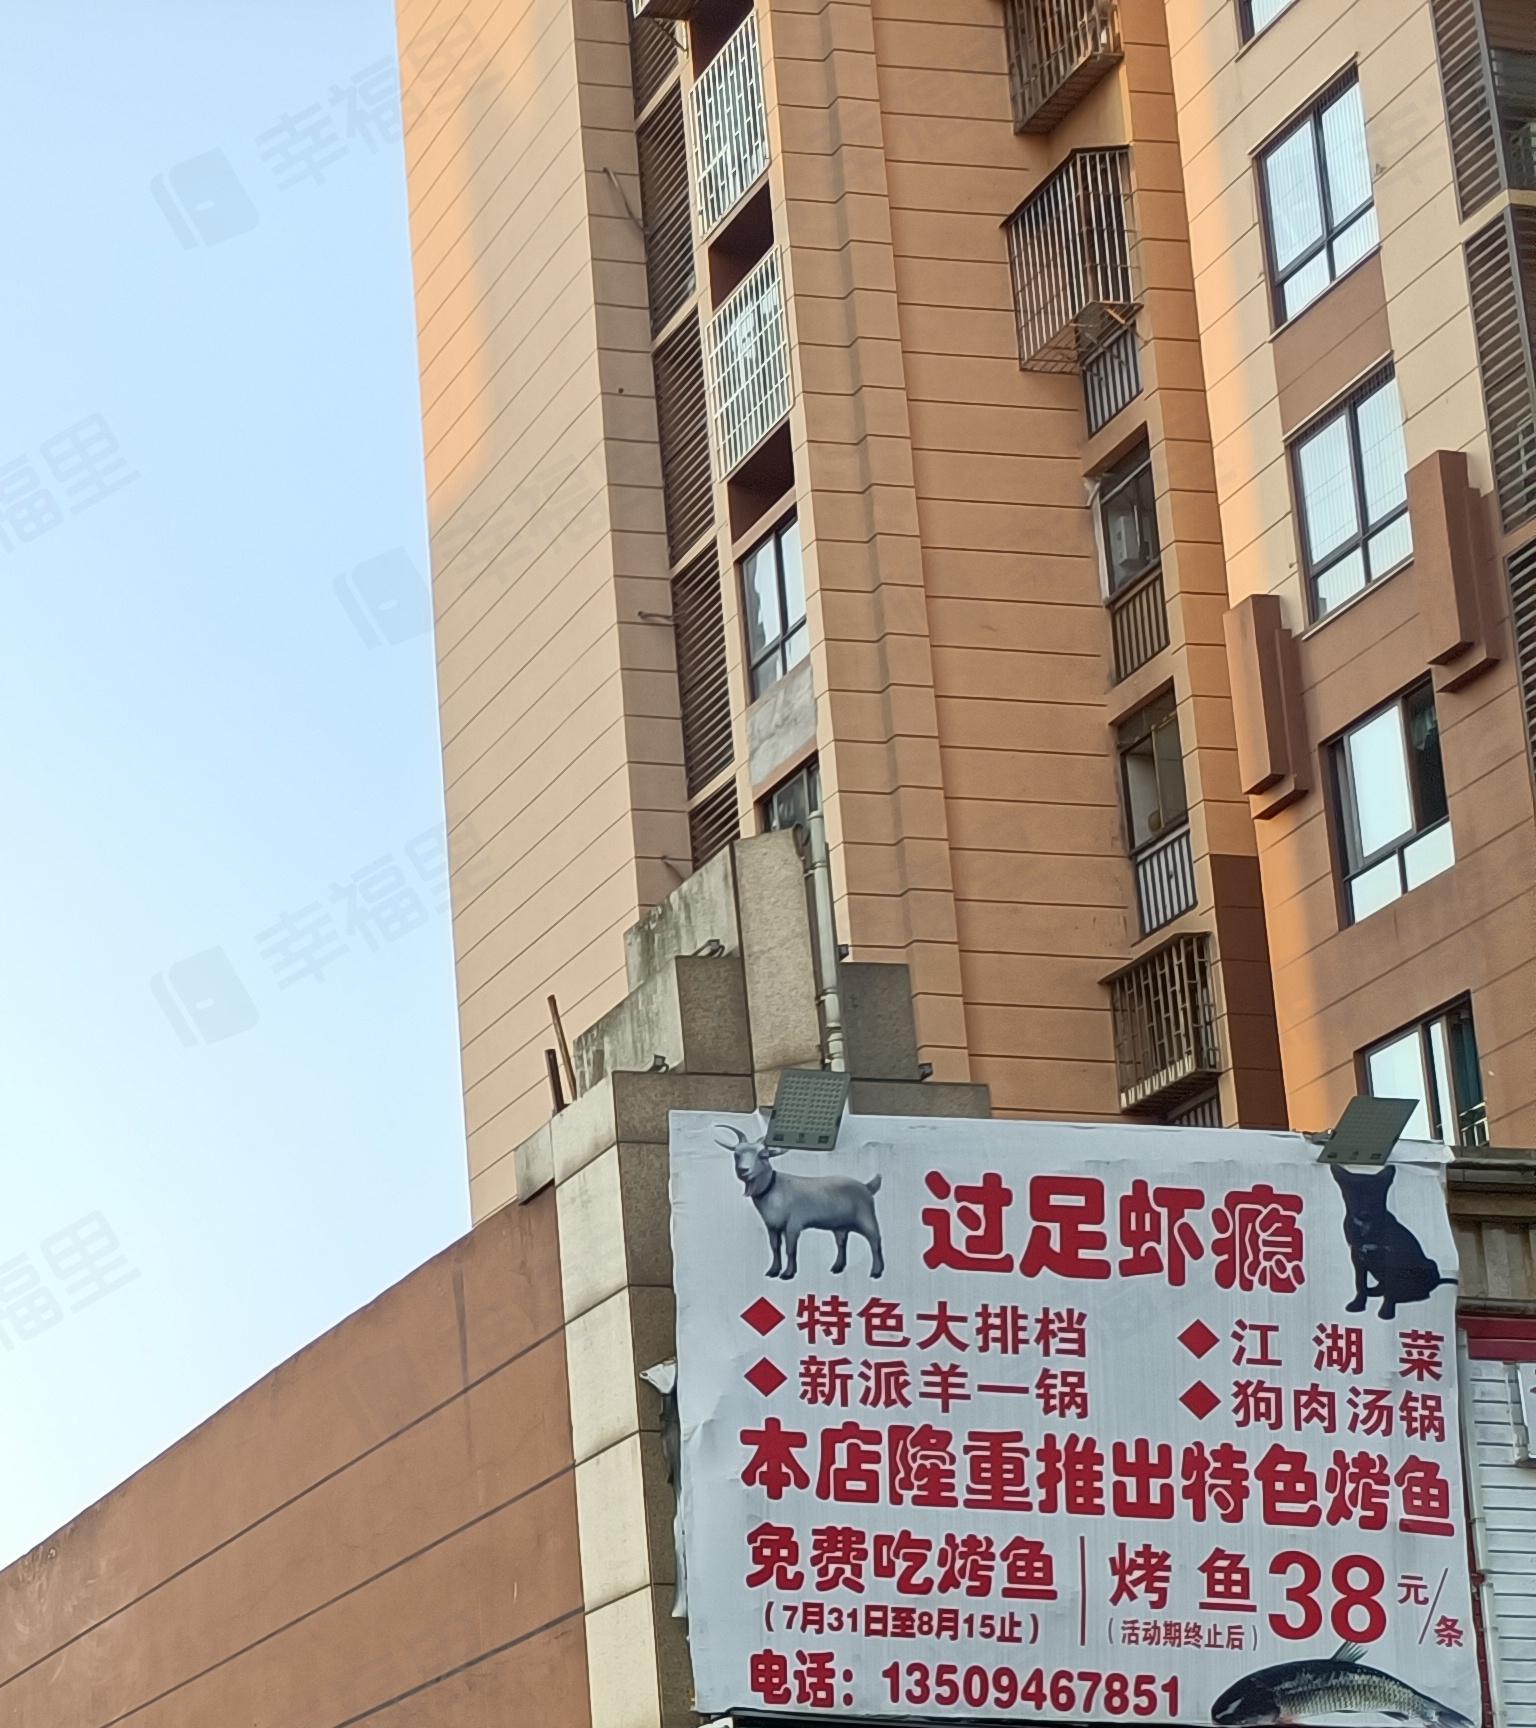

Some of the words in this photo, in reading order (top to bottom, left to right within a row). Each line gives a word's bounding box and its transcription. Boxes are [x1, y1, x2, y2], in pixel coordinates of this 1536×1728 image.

[922, 1171, 1306, 1295] 过足虾瘾
[795, 1294, 1088, 1358] 特色大排档
[1230, 1318, 1444, 1382] 江湖菜
[797, 1355, 1088, 1419] 新派羊一锅
[1232, 1378, 1446, 1443] 狗肉汤锅
[740, 1417, 1455, 1538] 本店隆重推出特色烤鱼
[746, 1523, 1057, 1602] 免费吃烤鱼
[1109, 1542, 1257, 1613] 烤鱼
[882, 1661, 1180, 1718] 13509467851
